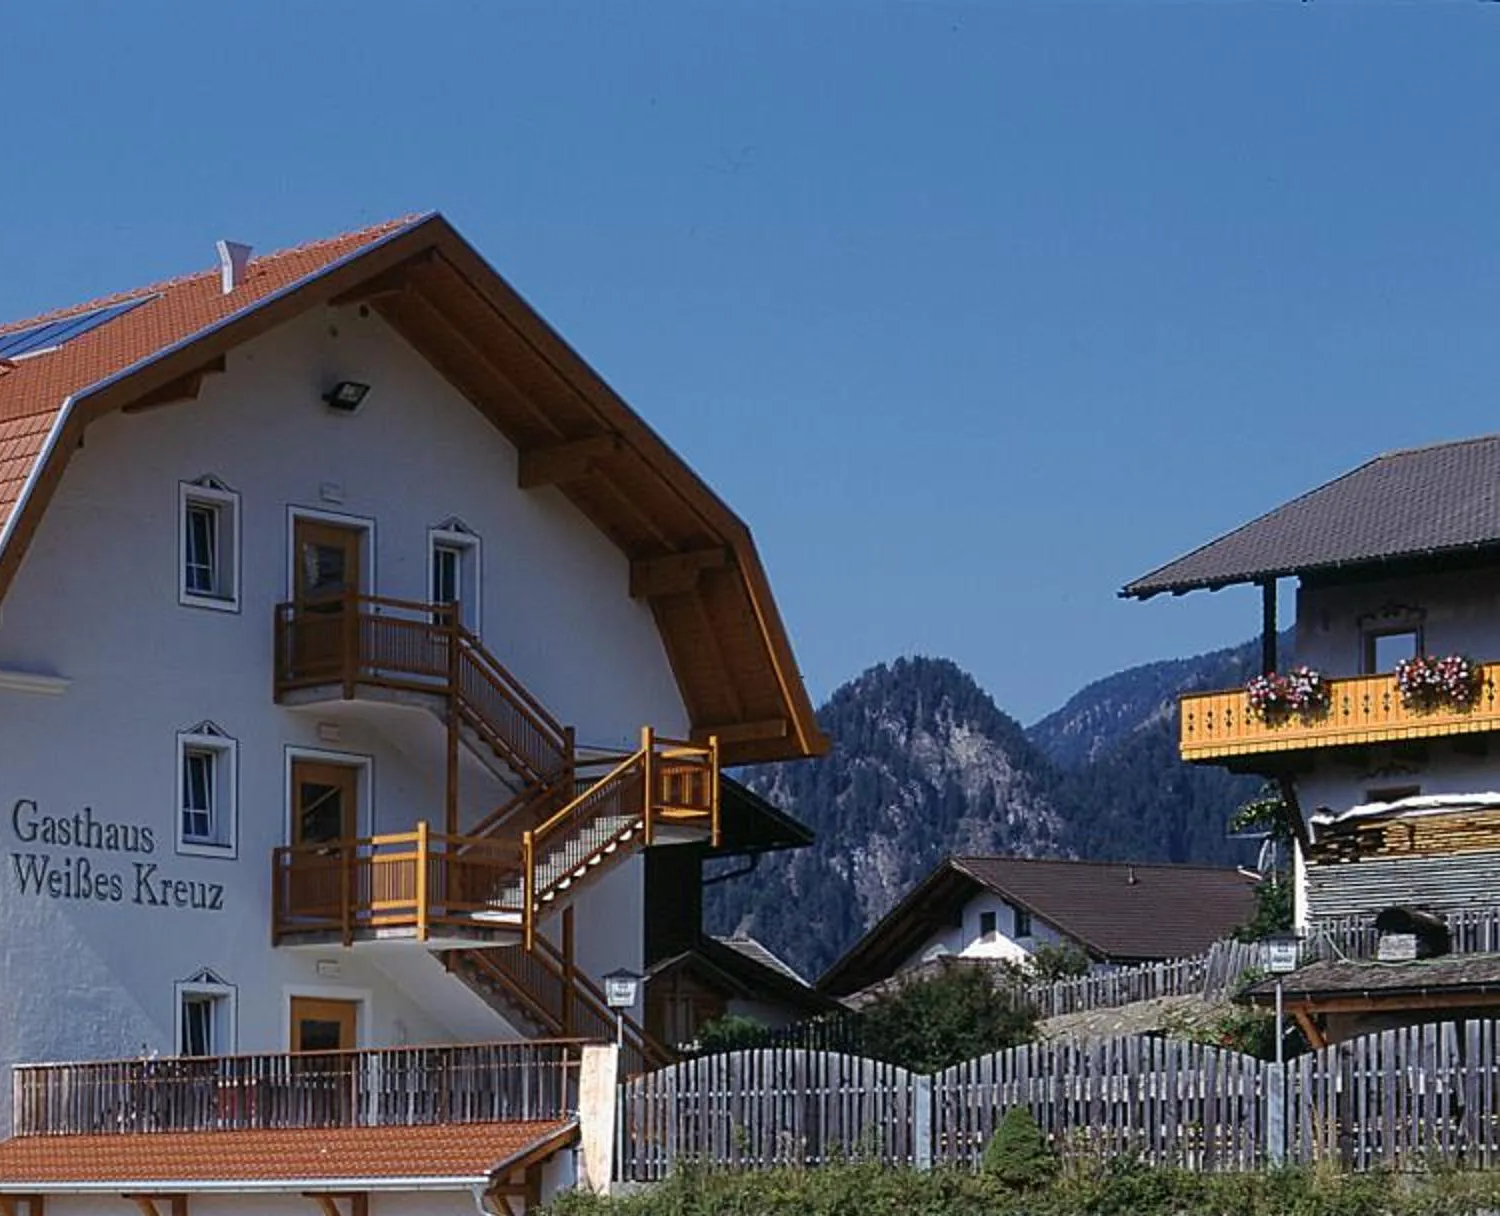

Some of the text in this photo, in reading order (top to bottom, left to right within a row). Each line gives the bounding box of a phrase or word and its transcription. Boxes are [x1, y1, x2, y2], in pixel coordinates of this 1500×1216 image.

[12, 799, 154, 854] Gasthaus
[10, 852, 224, 910] Weißes Kreuz
